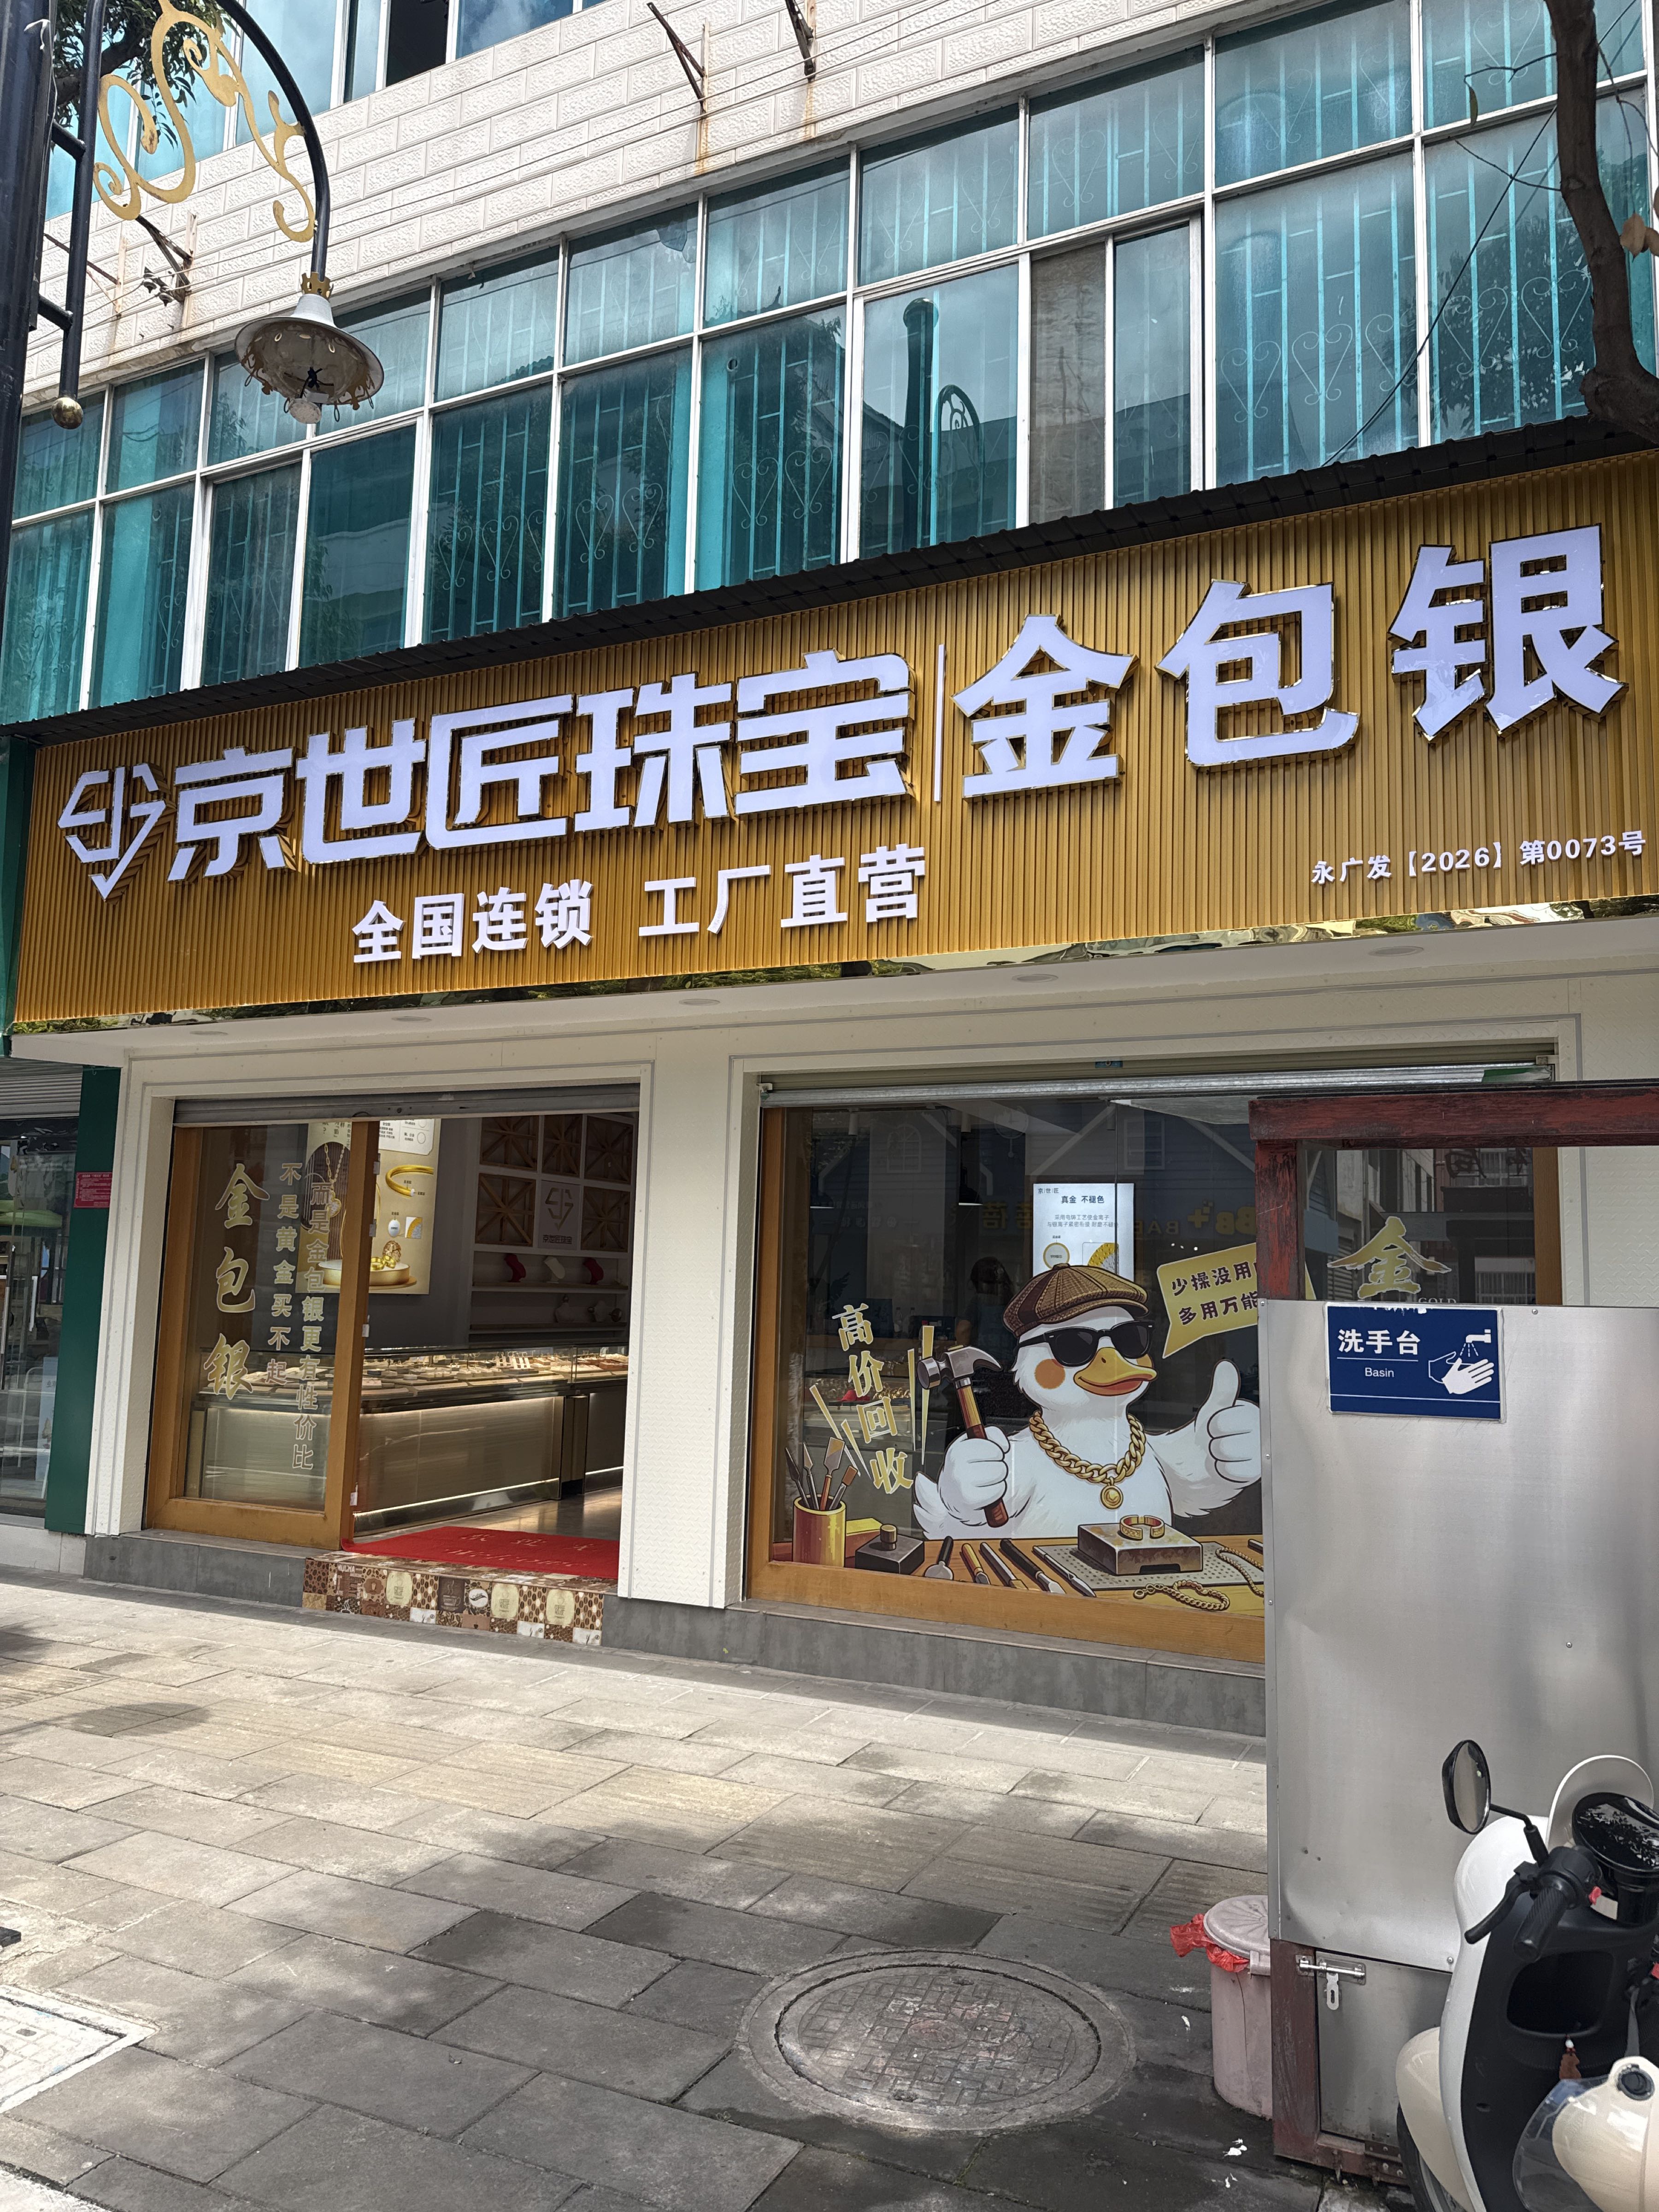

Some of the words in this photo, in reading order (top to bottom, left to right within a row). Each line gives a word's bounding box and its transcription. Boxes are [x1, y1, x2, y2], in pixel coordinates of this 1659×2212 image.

[168, 648, 914, 882] 京世匠珠宝
[952, 524, 1629, 798] 金包银
[352, 879, 593, 964] 全国连锁
[639, 843, 926, 936] 工厂直营
[1061, 1195, 1077, 1204] 真金
[1081, 1195, 1104, 1204] 不褪色
[1327, 1216, 1452, 1299] 金
[204, 1163, 270, 1400] 金包银
[265, 1163, 303, 1385] 不是黄金买不起
[293, 1182, 331, 1470] 而是金包银更有性价比
[1171, 1260, 1257, 1296] 少操没用
[832, 1303, 913, 1494] 高价回收
[1338, 1329, 1421, 1355] 洗手台
[1365, 1367, 1394, 1377] Basin
